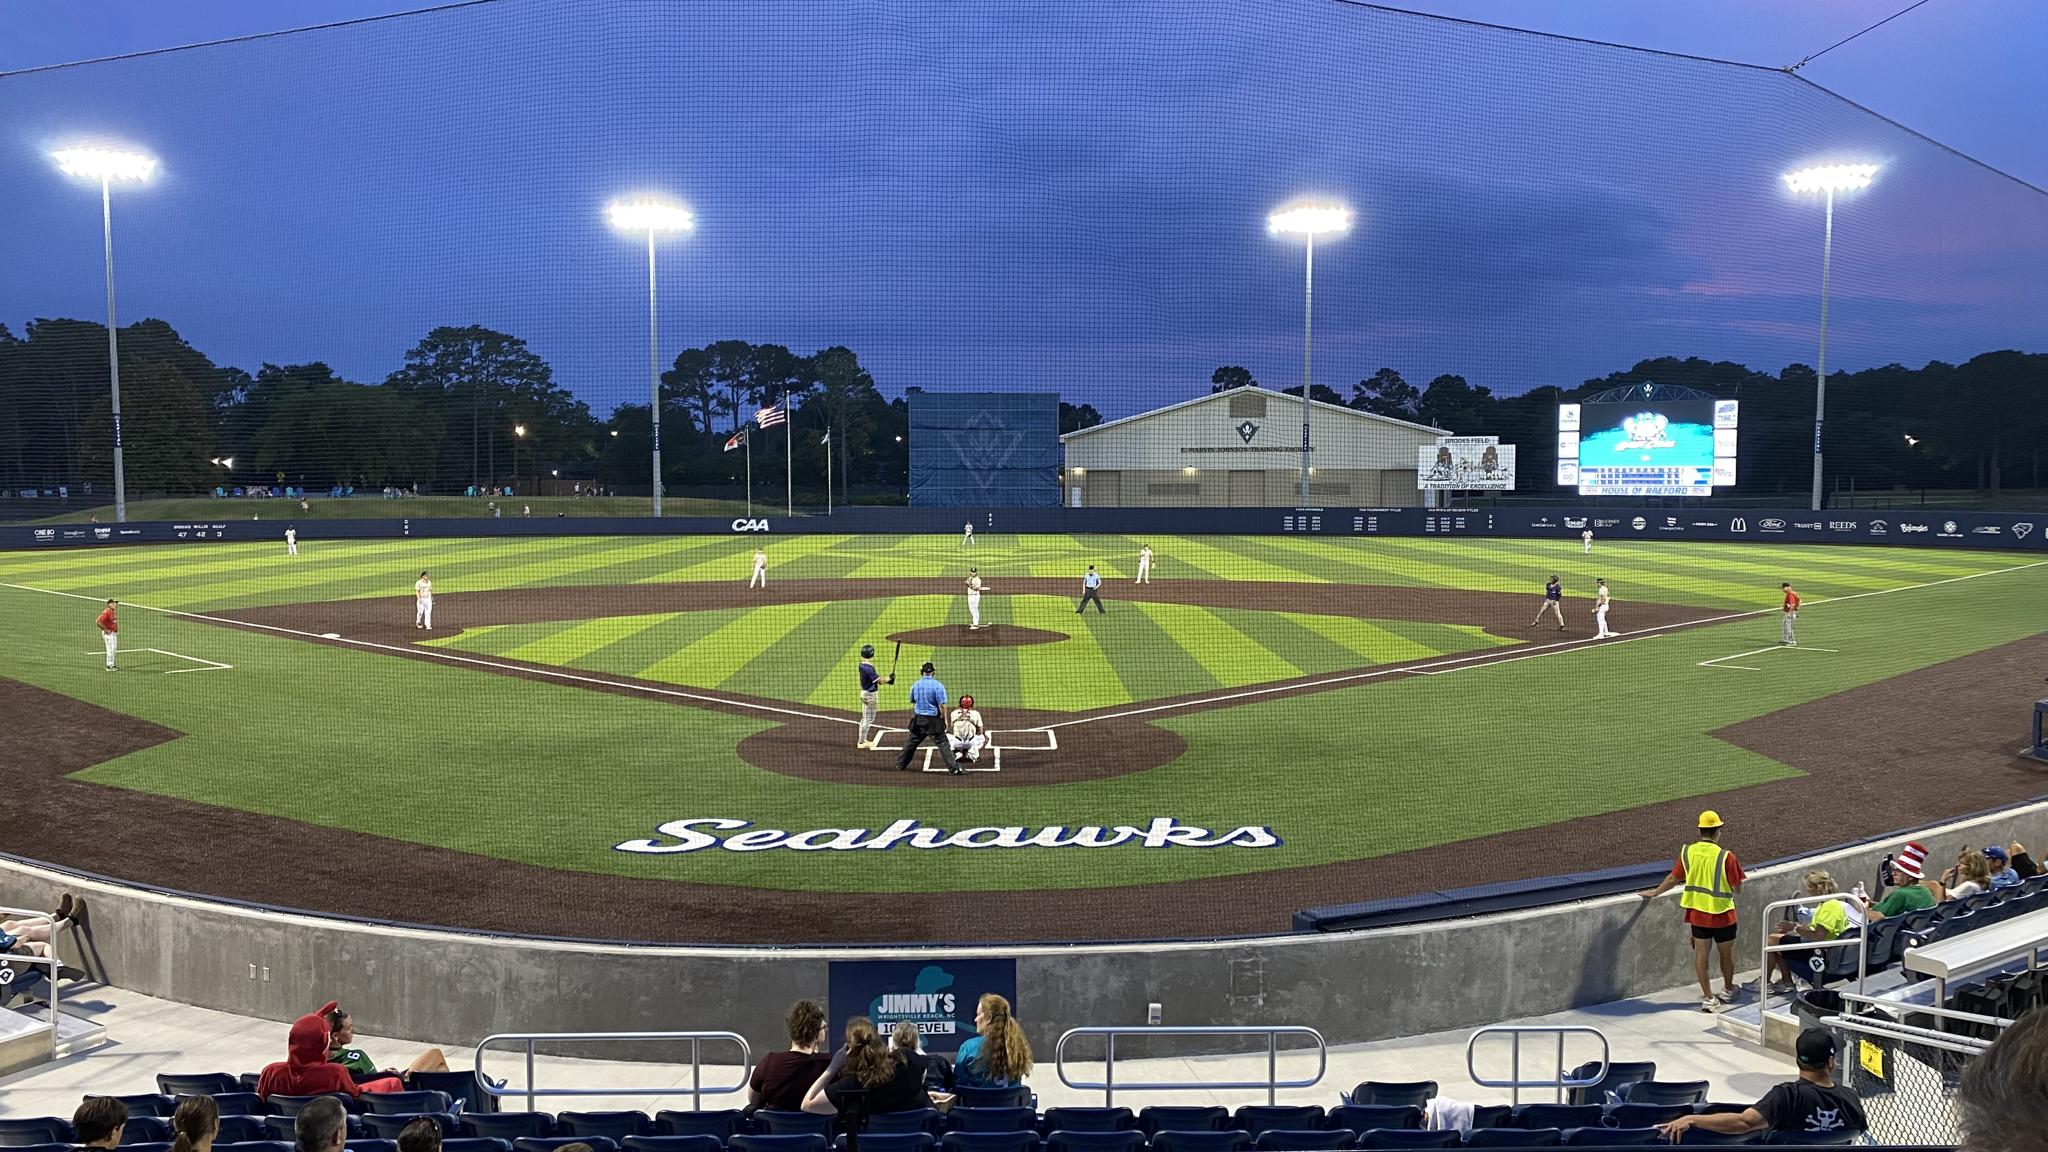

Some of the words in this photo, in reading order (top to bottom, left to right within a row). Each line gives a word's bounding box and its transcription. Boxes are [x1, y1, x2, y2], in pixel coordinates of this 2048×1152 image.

[1602, 487, 1630, 495] HOUSE
[1632, 487, 1643, 495] OF
[1645, 487, 1688, 495] RAEFORD
[731, 518, 770, 532] CAA
[1829, 521, 1857, 529] REEDS
[614, 817, 1283, 853] Seahawks
[877, 993, 956, 1014] JIMMY'S
[917, 1023, 950, 1033] EVEL
